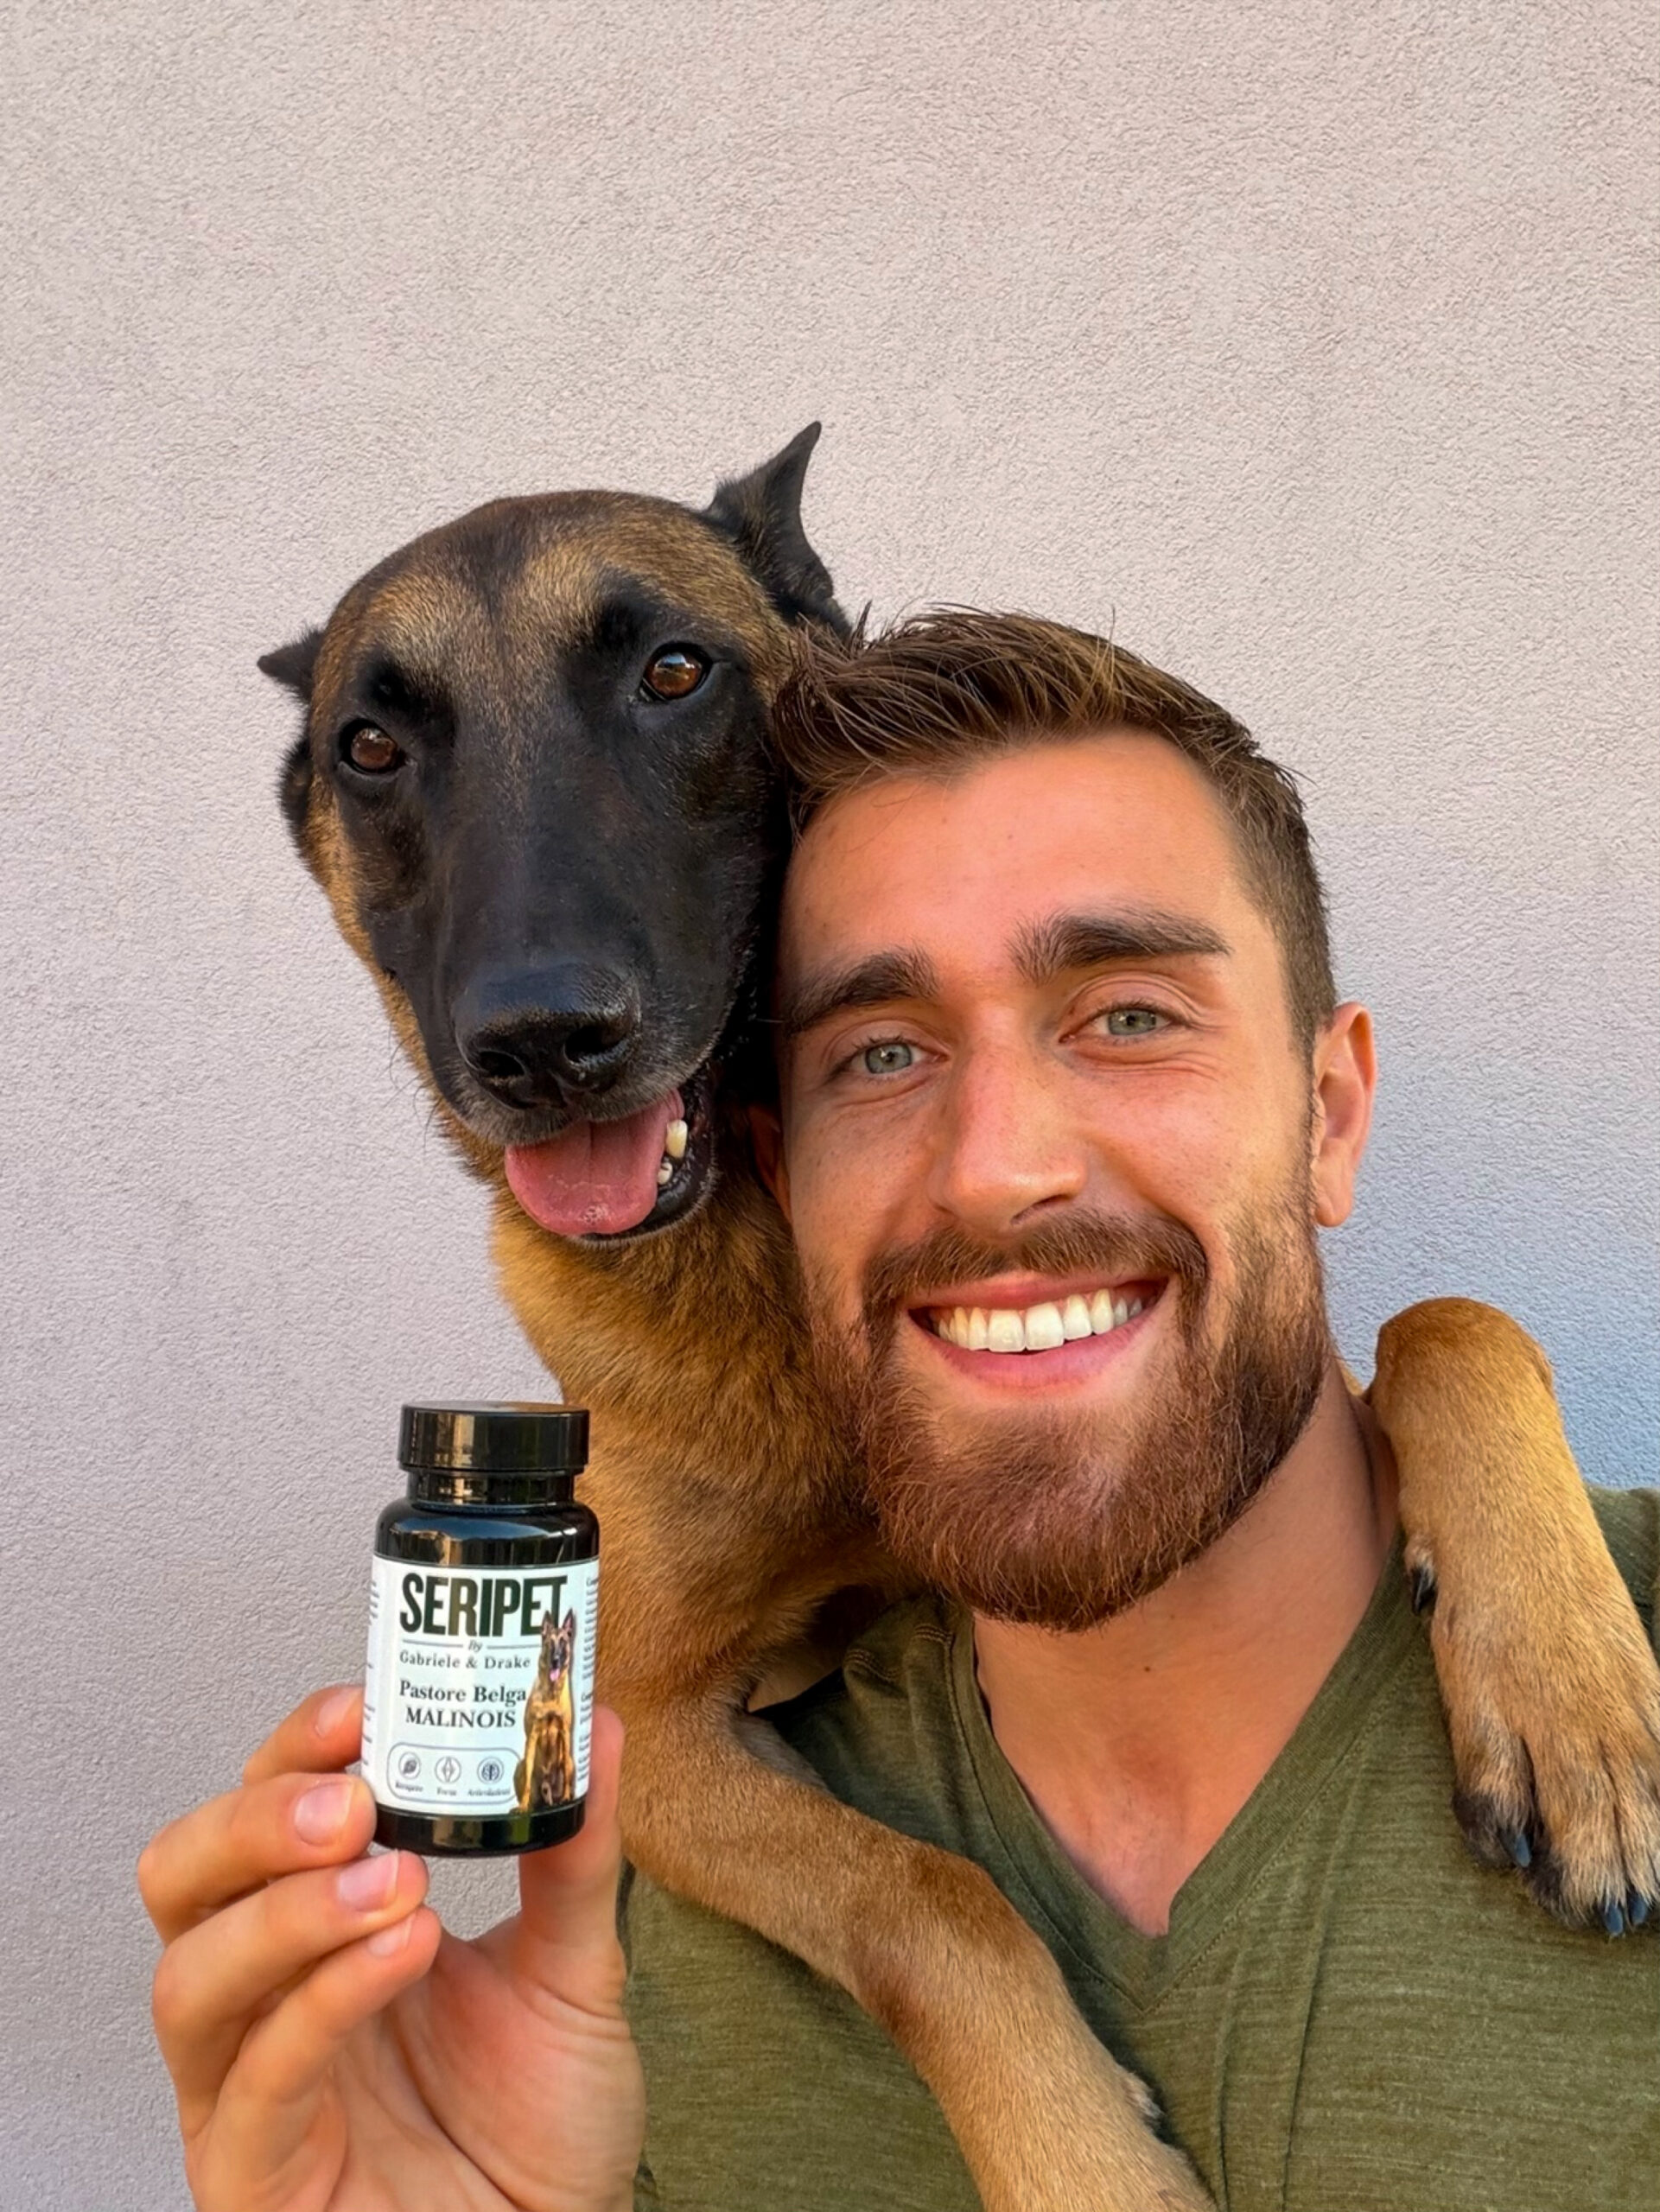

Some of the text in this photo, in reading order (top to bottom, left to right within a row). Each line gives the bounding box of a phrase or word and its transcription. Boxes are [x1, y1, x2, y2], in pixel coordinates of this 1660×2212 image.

[400, 1572, 568, 1637] SERIPET
[399, 1649, 531, 1669] Gabriele & Drake
[399, 1678, 526, 1707] Pastore Belga
[405, 1705, 516, 1728] MALINOIS
